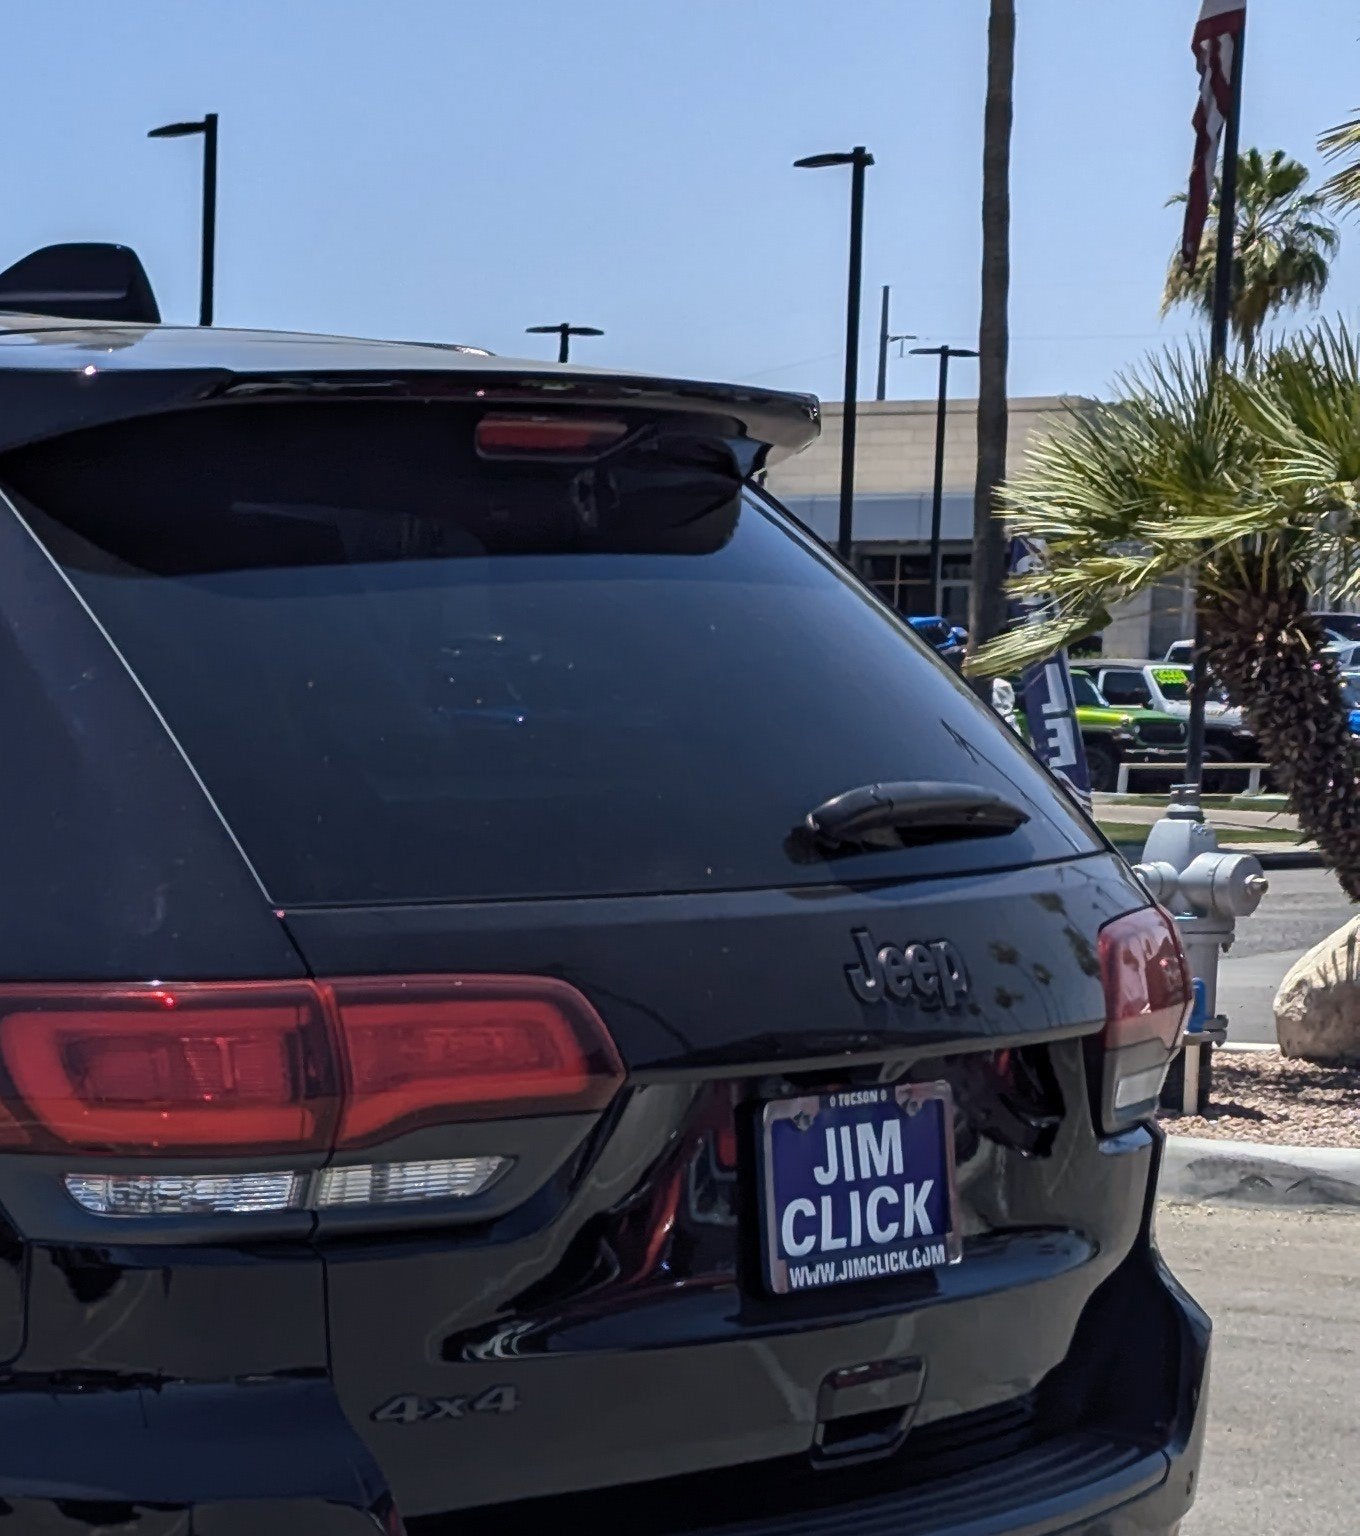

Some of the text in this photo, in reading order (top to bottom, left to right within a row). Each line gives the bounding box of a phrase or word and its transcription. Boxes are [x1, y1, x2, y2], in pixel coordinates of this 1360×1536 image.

[844, 926, 972, 1009] Jeep
[838, 1089, 878, 1107] TUCSON
[813, 1119, 904, 1186] JIM
[781, 1179, 935, 1257] CLICK
[789, 1244, 946, 1289] WWW.JIMCLICK.COM
[369, 1382, 523, 1424] 4x4
